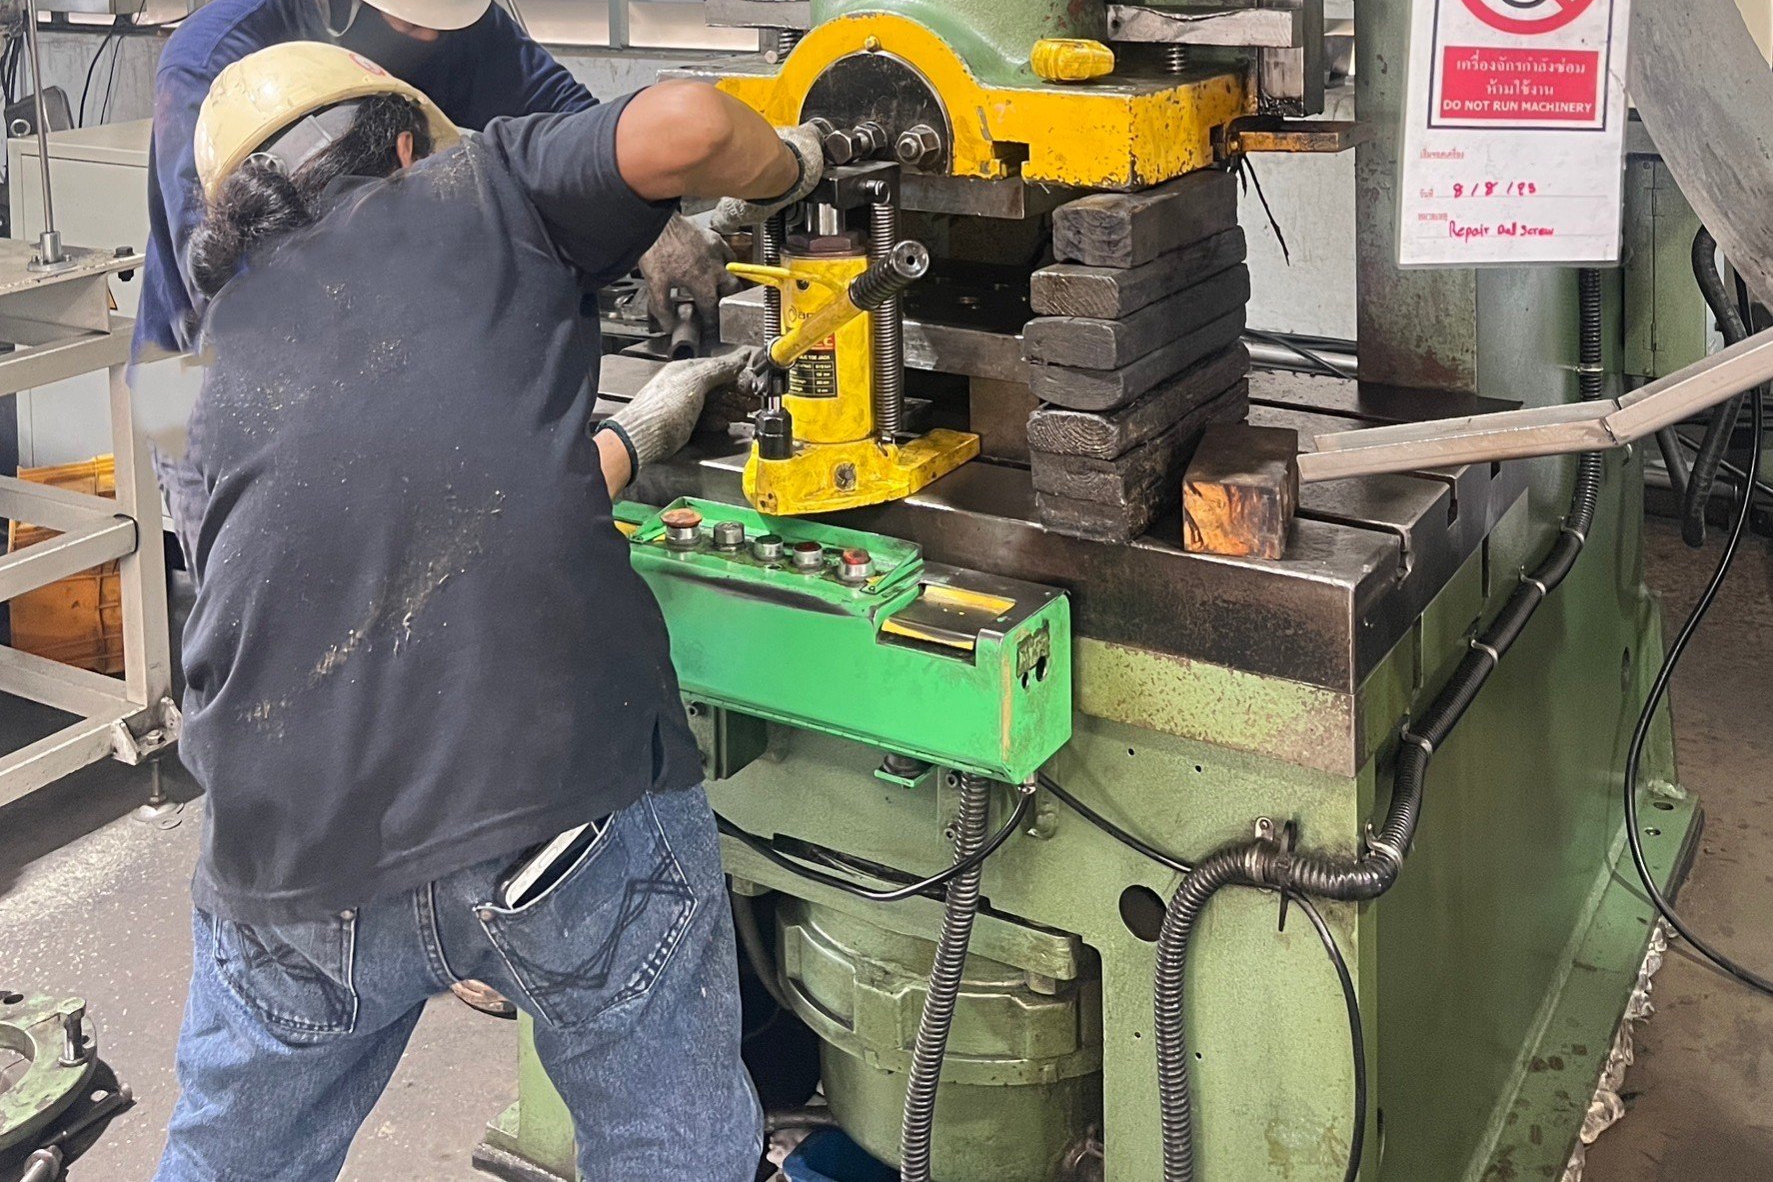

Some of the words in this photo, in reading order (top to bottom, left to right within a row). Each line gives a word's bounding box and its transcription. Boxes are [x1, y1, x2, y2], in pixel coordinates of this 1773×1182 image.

[1457, 50, 1586, 74] เครื่องจักรกำลังซ่อม
[1486, 79, 1554, 96] ห้ามใช้งาน
[1443, 99, 1461, 111] DO
[1464, 100, 1490, 111] NOT
[1493, 101, 1518, 112] RUN
[1521, 101, 1592, 113] MACHINERY
[1449, 220, 1491, 244] Repair
